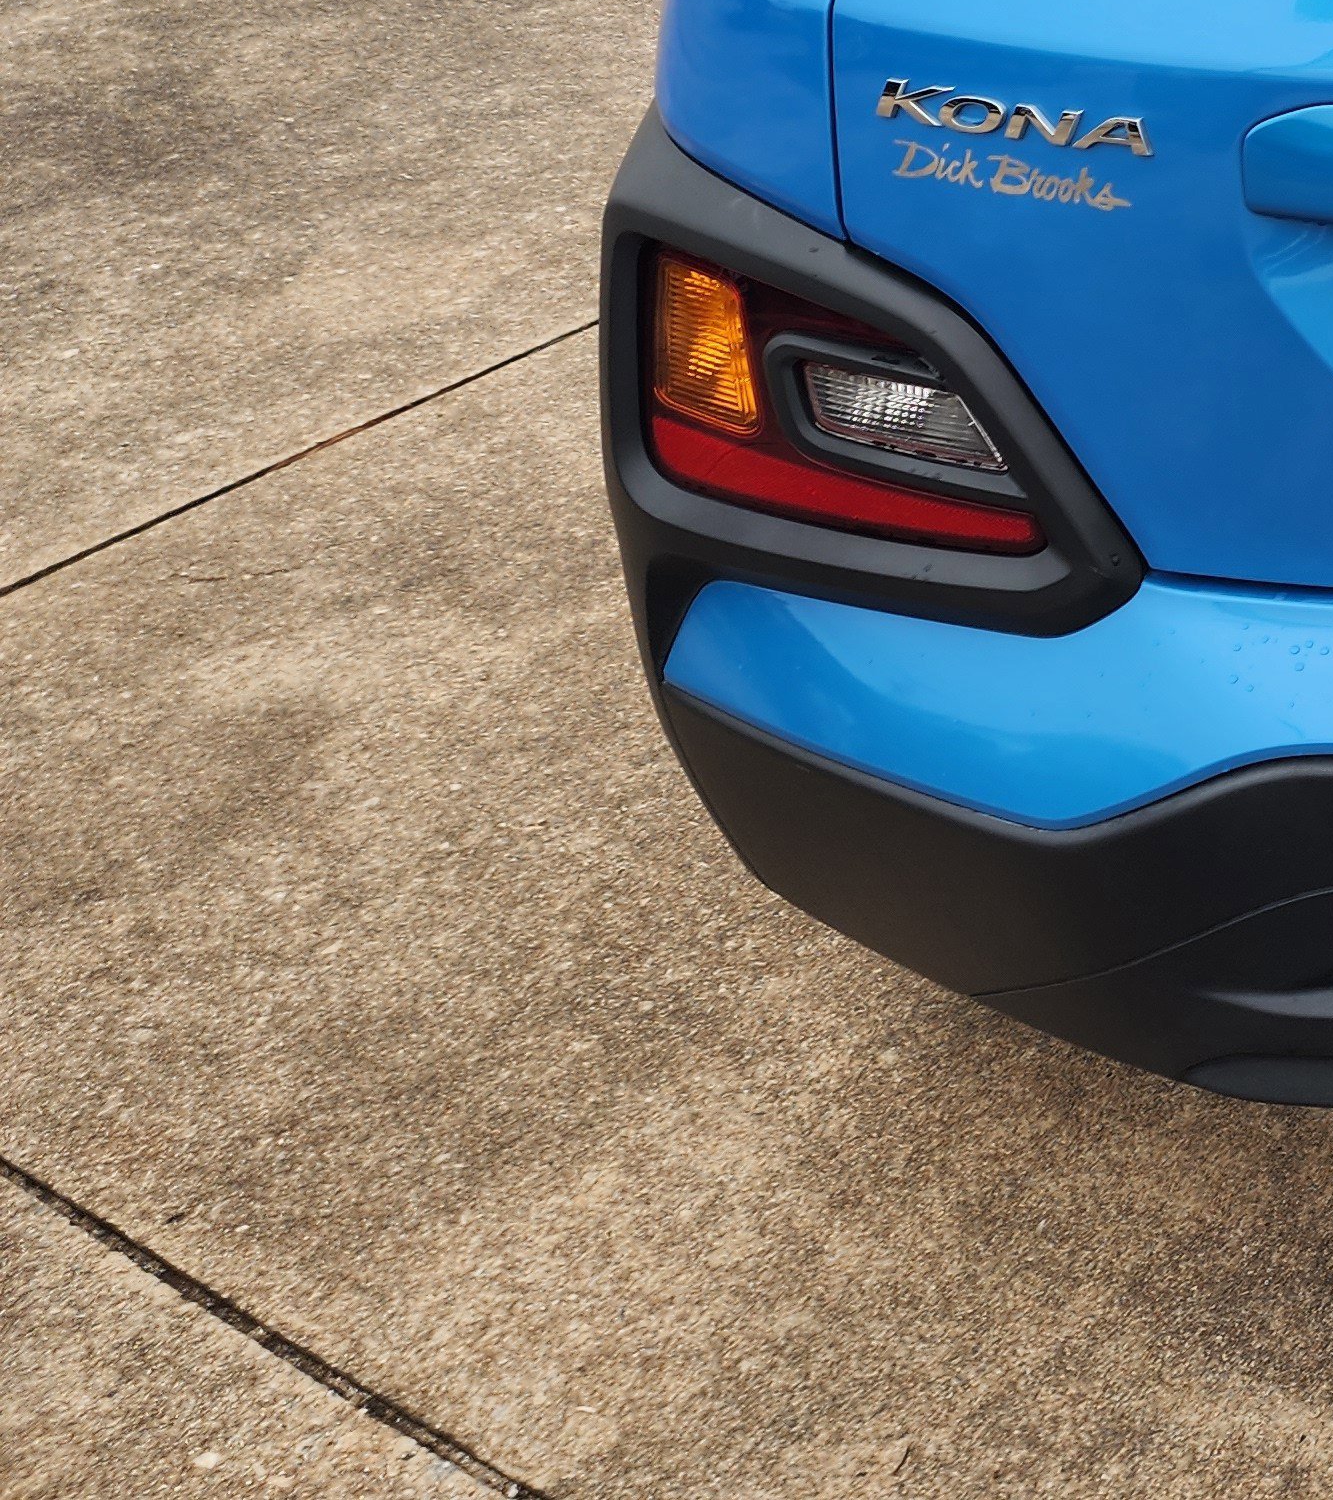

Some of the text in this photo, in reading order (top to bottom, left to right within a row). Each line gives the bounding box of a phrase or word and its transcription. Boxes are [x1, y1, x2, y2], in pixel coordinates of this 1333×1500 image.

[876, 76, 1155, 157] KONA
[891, 139, 1132, 212] Dick Brooks
